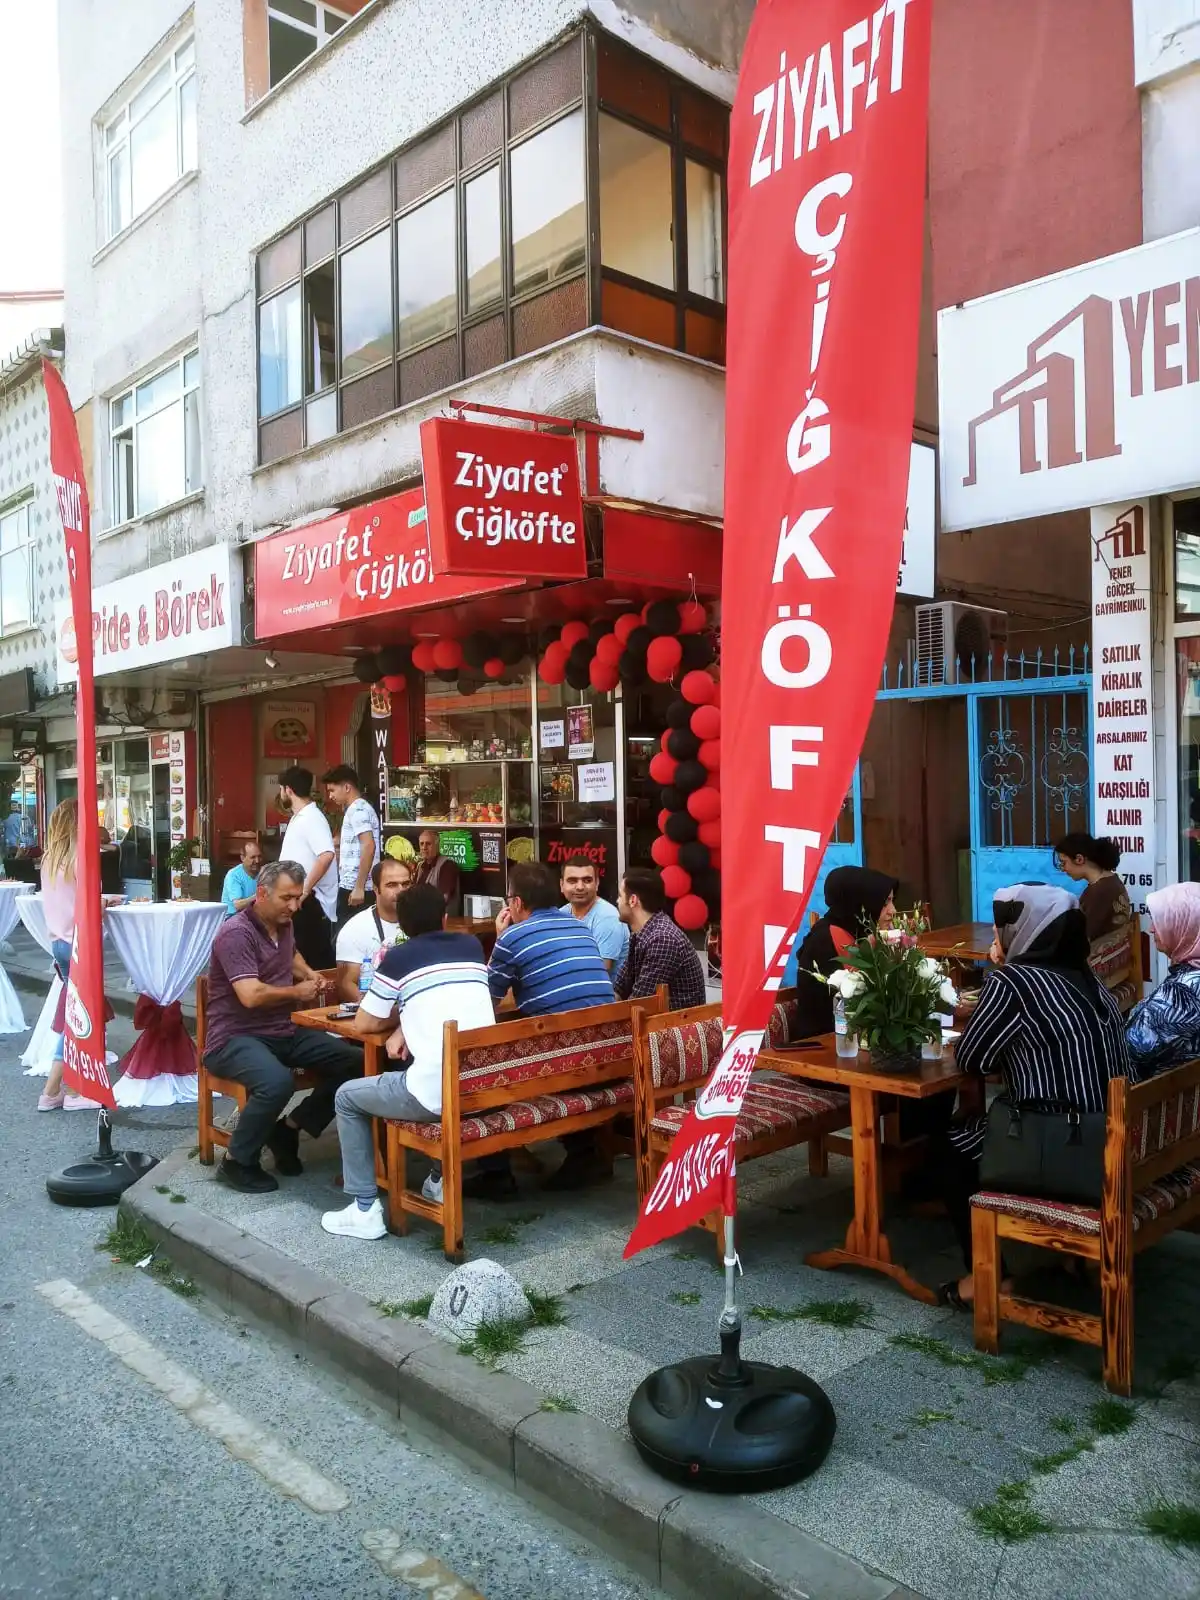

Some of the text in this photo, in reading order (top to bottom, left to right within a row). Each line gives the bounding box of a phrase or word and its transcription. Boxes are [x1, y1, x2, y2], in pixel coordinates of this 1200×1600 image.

[454, 451, 563, 499] Ziyafet
[455, 506, 576, 546] Çiğköfte
[282, 524, 373, 585] Ziyafet
[1109, 565, 1133, 580] YENER
[1106, 582, 1136, 598] GÖKÇEK
[92, 573, 226, 658] Pide & Börek
[1095, 598, 1147, 616] GAYRİMENKUL
[1102, 643, 1141, 664] SATILIK
[1101, 672, 1143, 691] KİRALIK
[1097, 698, 1148, 718] DAİRELER
[1096, 731, 1148, 744] ARSALARINIZ
[1113, 755, 1134, 771] KAT
[1098, 777, 1150, 800] KARŞILIĞI
[1106, 809, 1143, 826] ALINIR
[1139, 875, 1153, 887] 65
